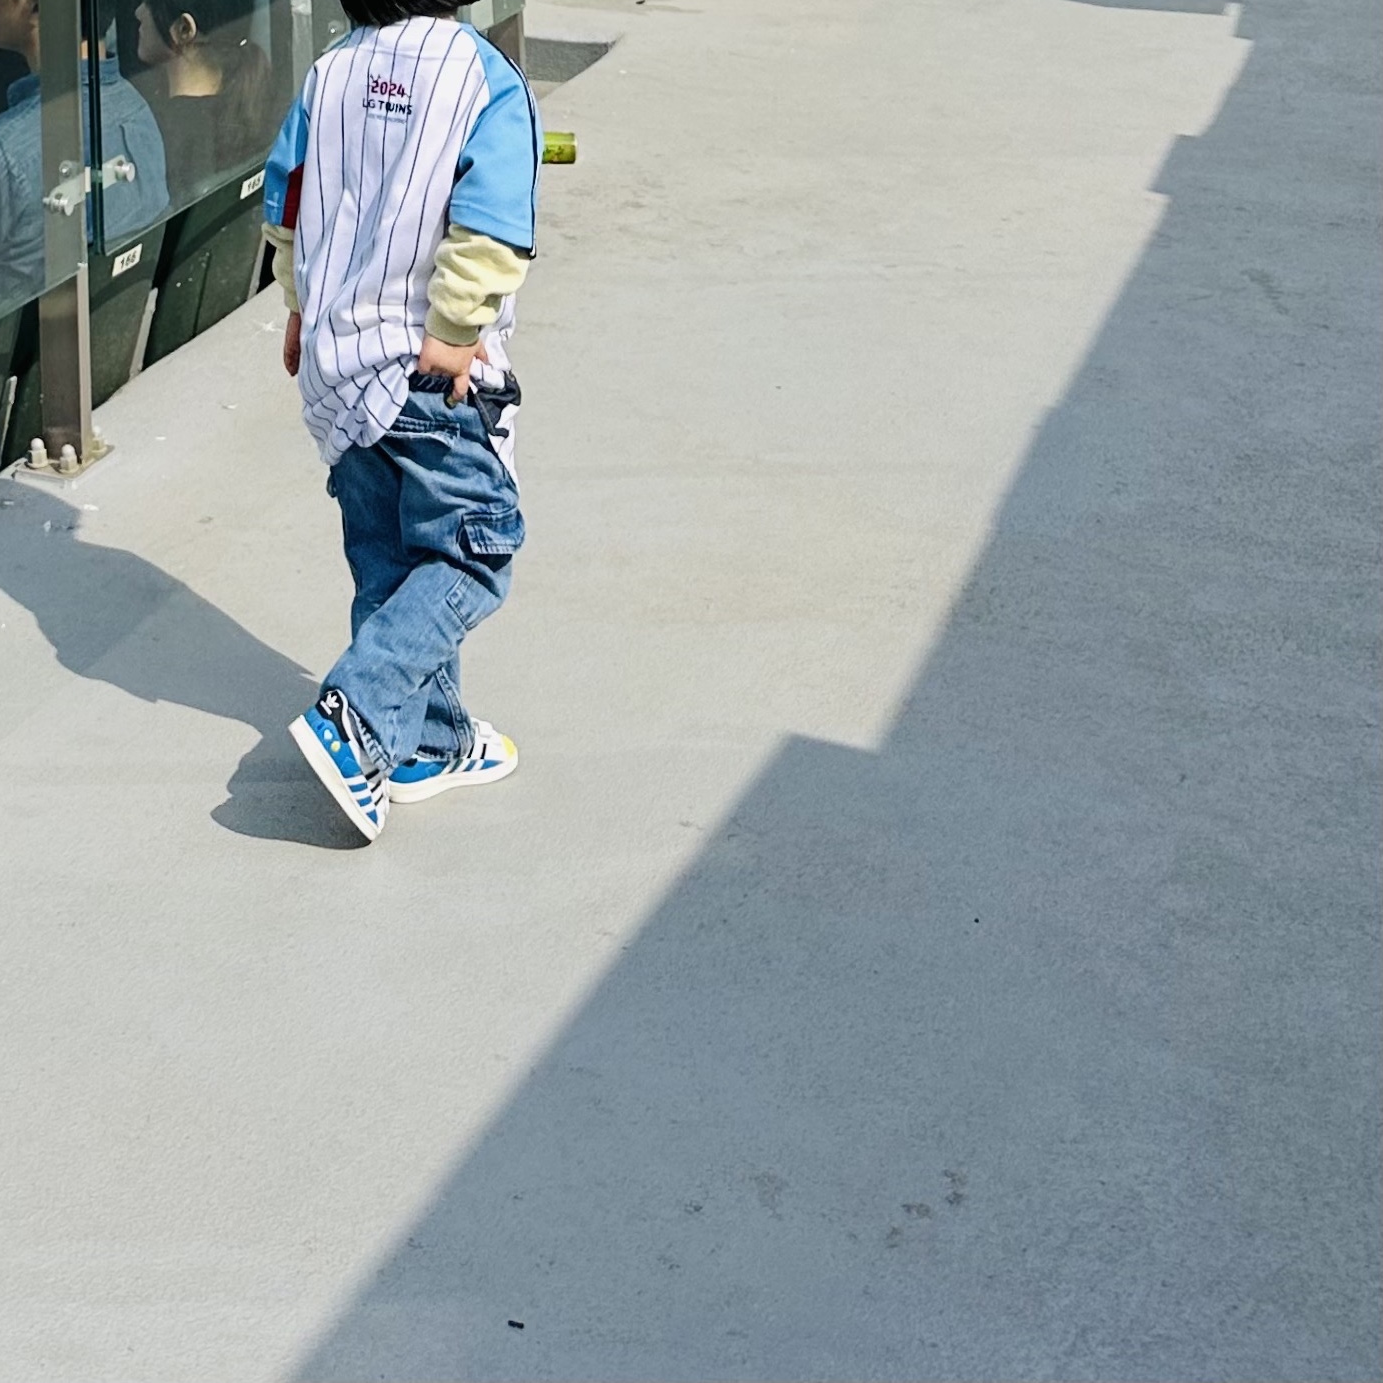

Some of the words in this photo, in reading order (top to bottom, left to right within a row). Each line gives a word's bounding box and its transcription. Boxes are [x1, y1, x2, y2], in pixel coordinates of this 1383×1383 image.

[370, 79, 405, 98] 2024
[362, 97, 376, 109] LG
[378, 100, 413, 115] TWINS
